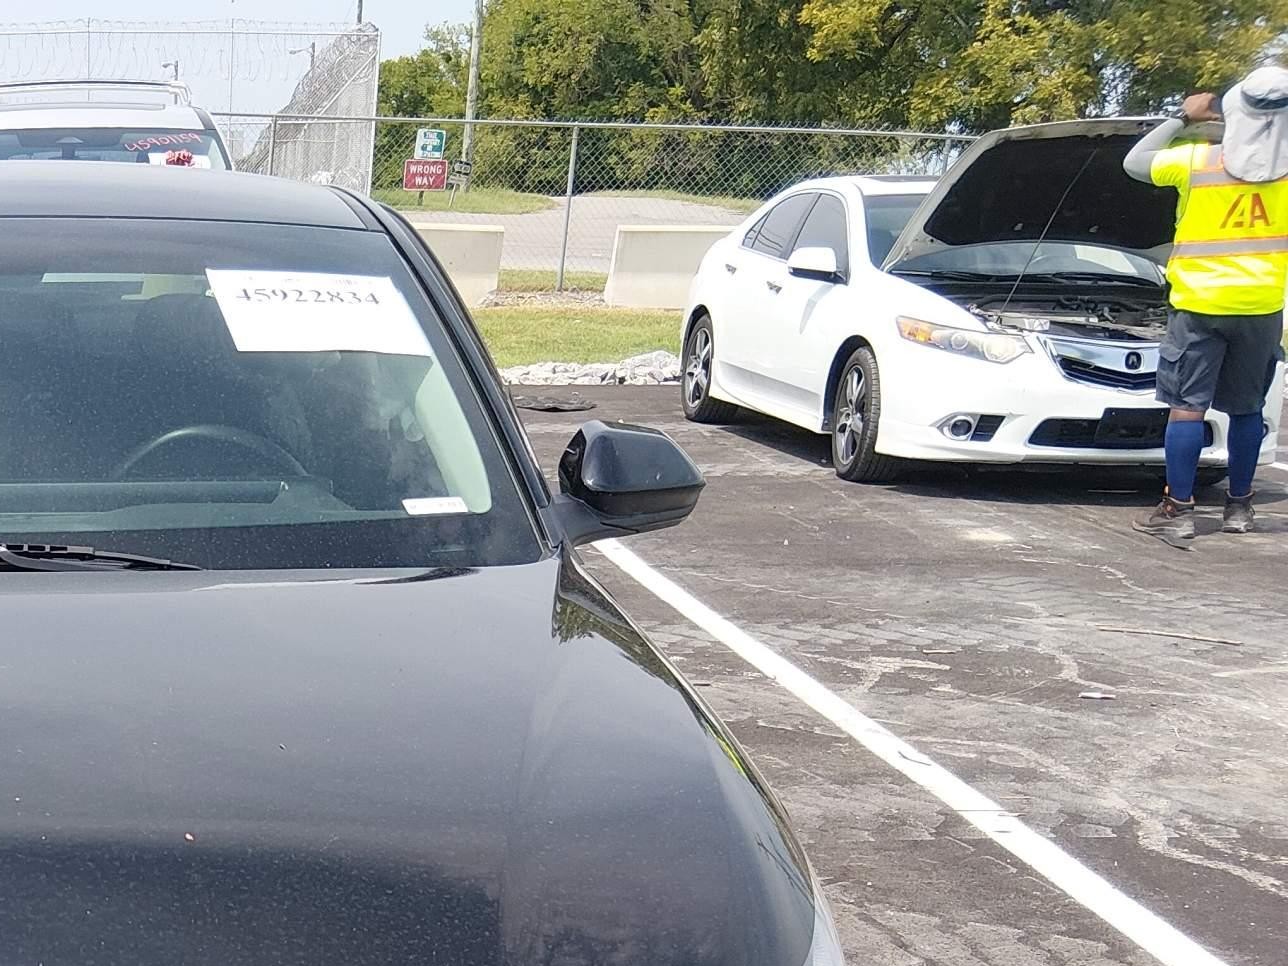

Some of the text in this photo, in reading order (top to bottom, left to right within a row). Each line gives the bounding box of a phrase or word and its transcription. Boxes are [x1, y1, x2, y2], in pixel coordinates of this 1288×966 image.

[124, 132, 203, 151] 45901159
[409, 164, 443, 175] WRONG
[415, 175, 435, 186] WAY
[235, 287, 380, 305] 45922834
